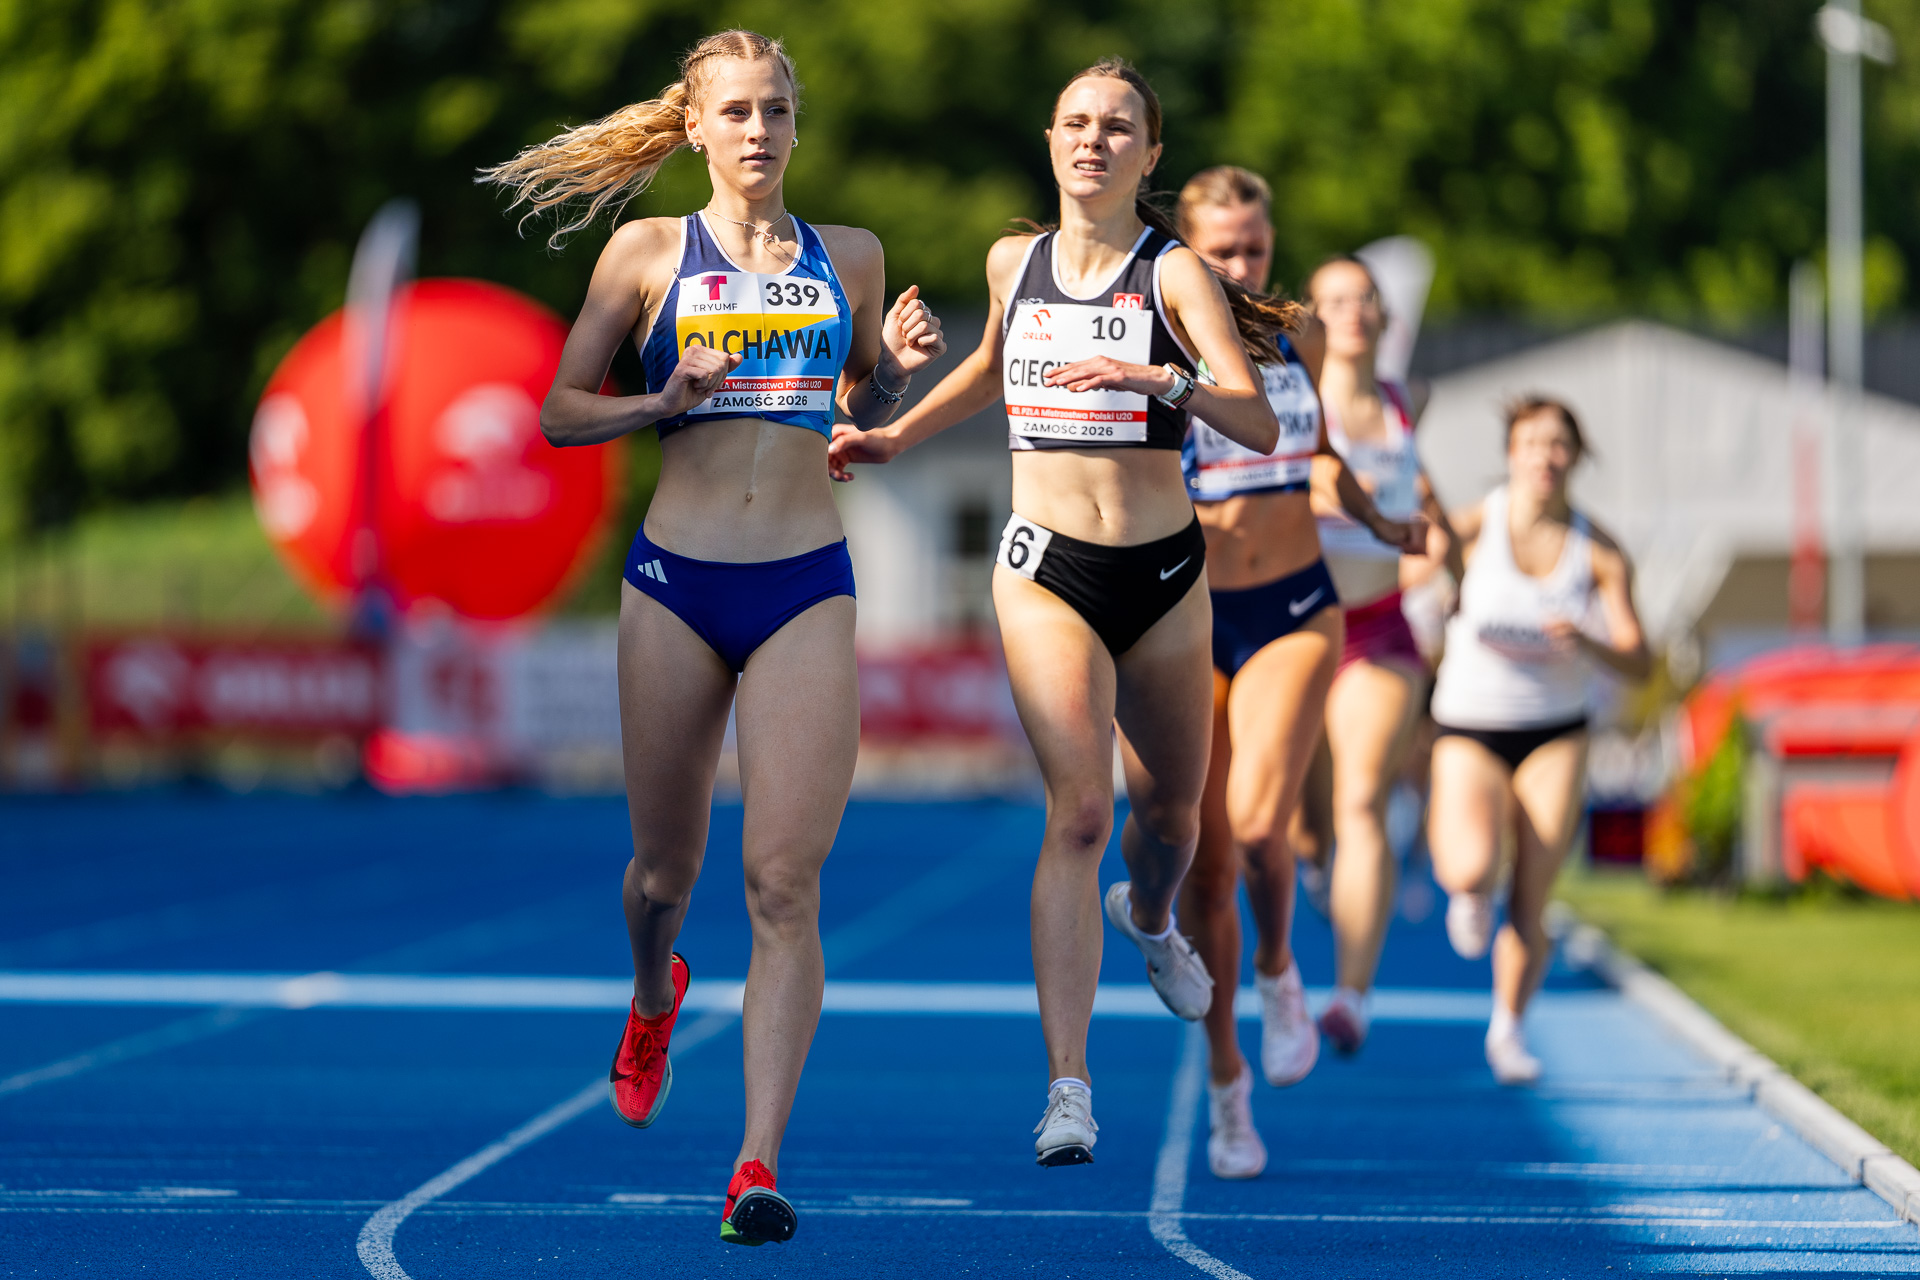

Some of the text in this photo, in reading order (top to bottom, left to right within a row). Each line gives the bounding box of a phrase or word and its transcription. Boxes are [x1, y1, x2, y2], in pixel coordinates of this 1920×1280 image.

[765, 282, 820, 307] 339
[692, 303, 738, 313] TRYUMF
[1092, 316, 1126, 341] 10
[1022, 332, 1052, 341] ORLEN
[732, 381, 784, 390] Mistrzostwa
[785, 380, 810, 389] Polski
[810, 380, 822, 389] U20
[713, 393, 808, 408] ZAMOŚĆ 2026
[1021, 407, 1040, 417] PZLA
[1040, 409, 1089, 421] Mistrzostwa
[1089, 411, 1114, 421] Polski
[1115, 412, 1134, 421] U20
[1023, 422, 1114, 437] ZAMOŚĆ 2026
[1008, 526, 1035, 569] 6
